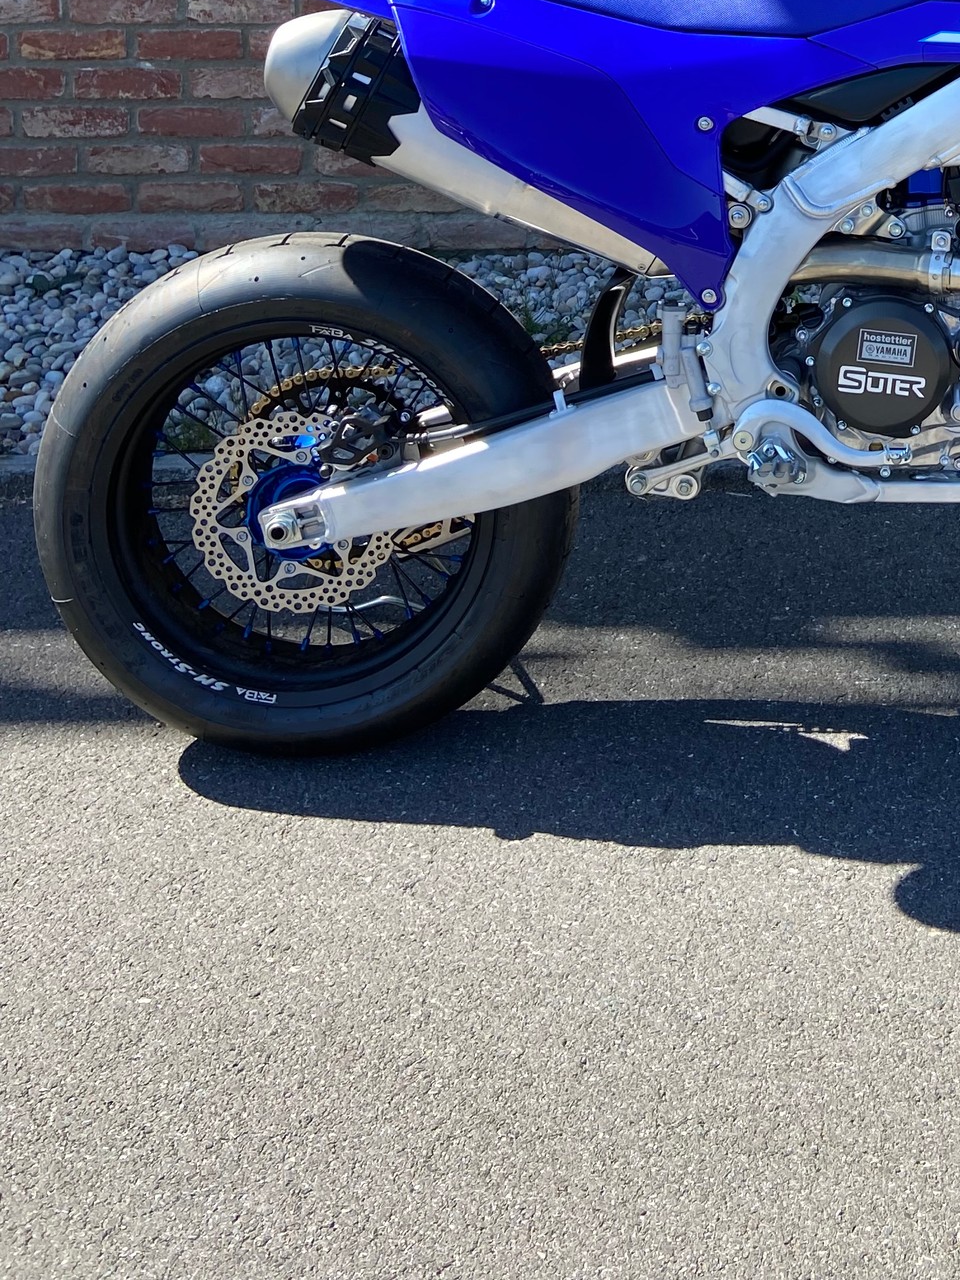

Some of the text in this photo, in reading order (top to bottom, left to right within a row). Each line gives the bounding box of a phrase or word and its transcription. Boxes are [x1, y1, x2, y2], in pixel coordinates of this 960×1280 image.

[863, 332, 913, 346] hostettler
[875, 345, 908, 358] YAMAHA
[837, 365, 926, 399] SUTER
[132, 622, 231, 692] SM-STRONG
